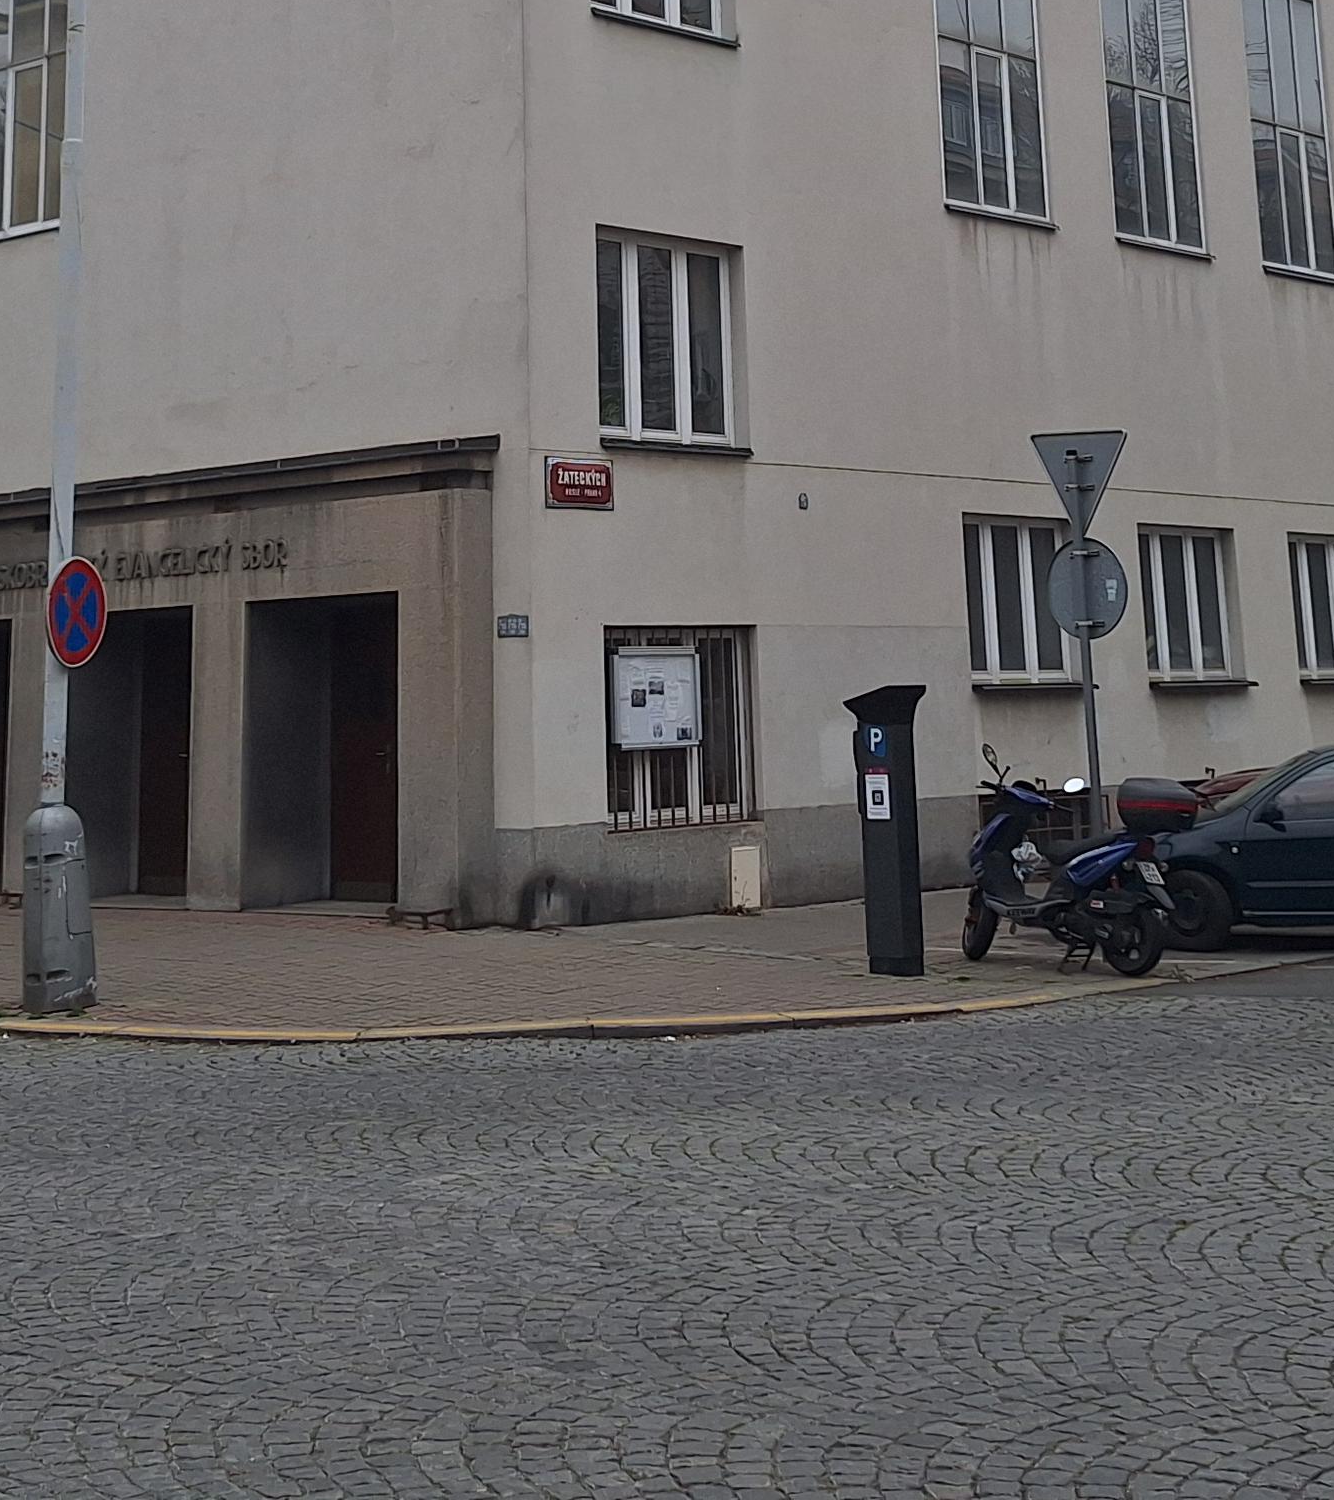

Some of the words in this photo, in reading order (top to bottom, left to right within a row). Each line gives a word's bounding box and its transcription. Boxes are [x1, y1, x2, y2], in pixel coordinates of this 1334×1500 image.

[557, 467, 607, 487] ŽATECKÝCH
[116, 539, 233, 582] EVANGELICKÝ
[242, 536, 288, 571] SBOR
[869, 727, 883, 753] P
